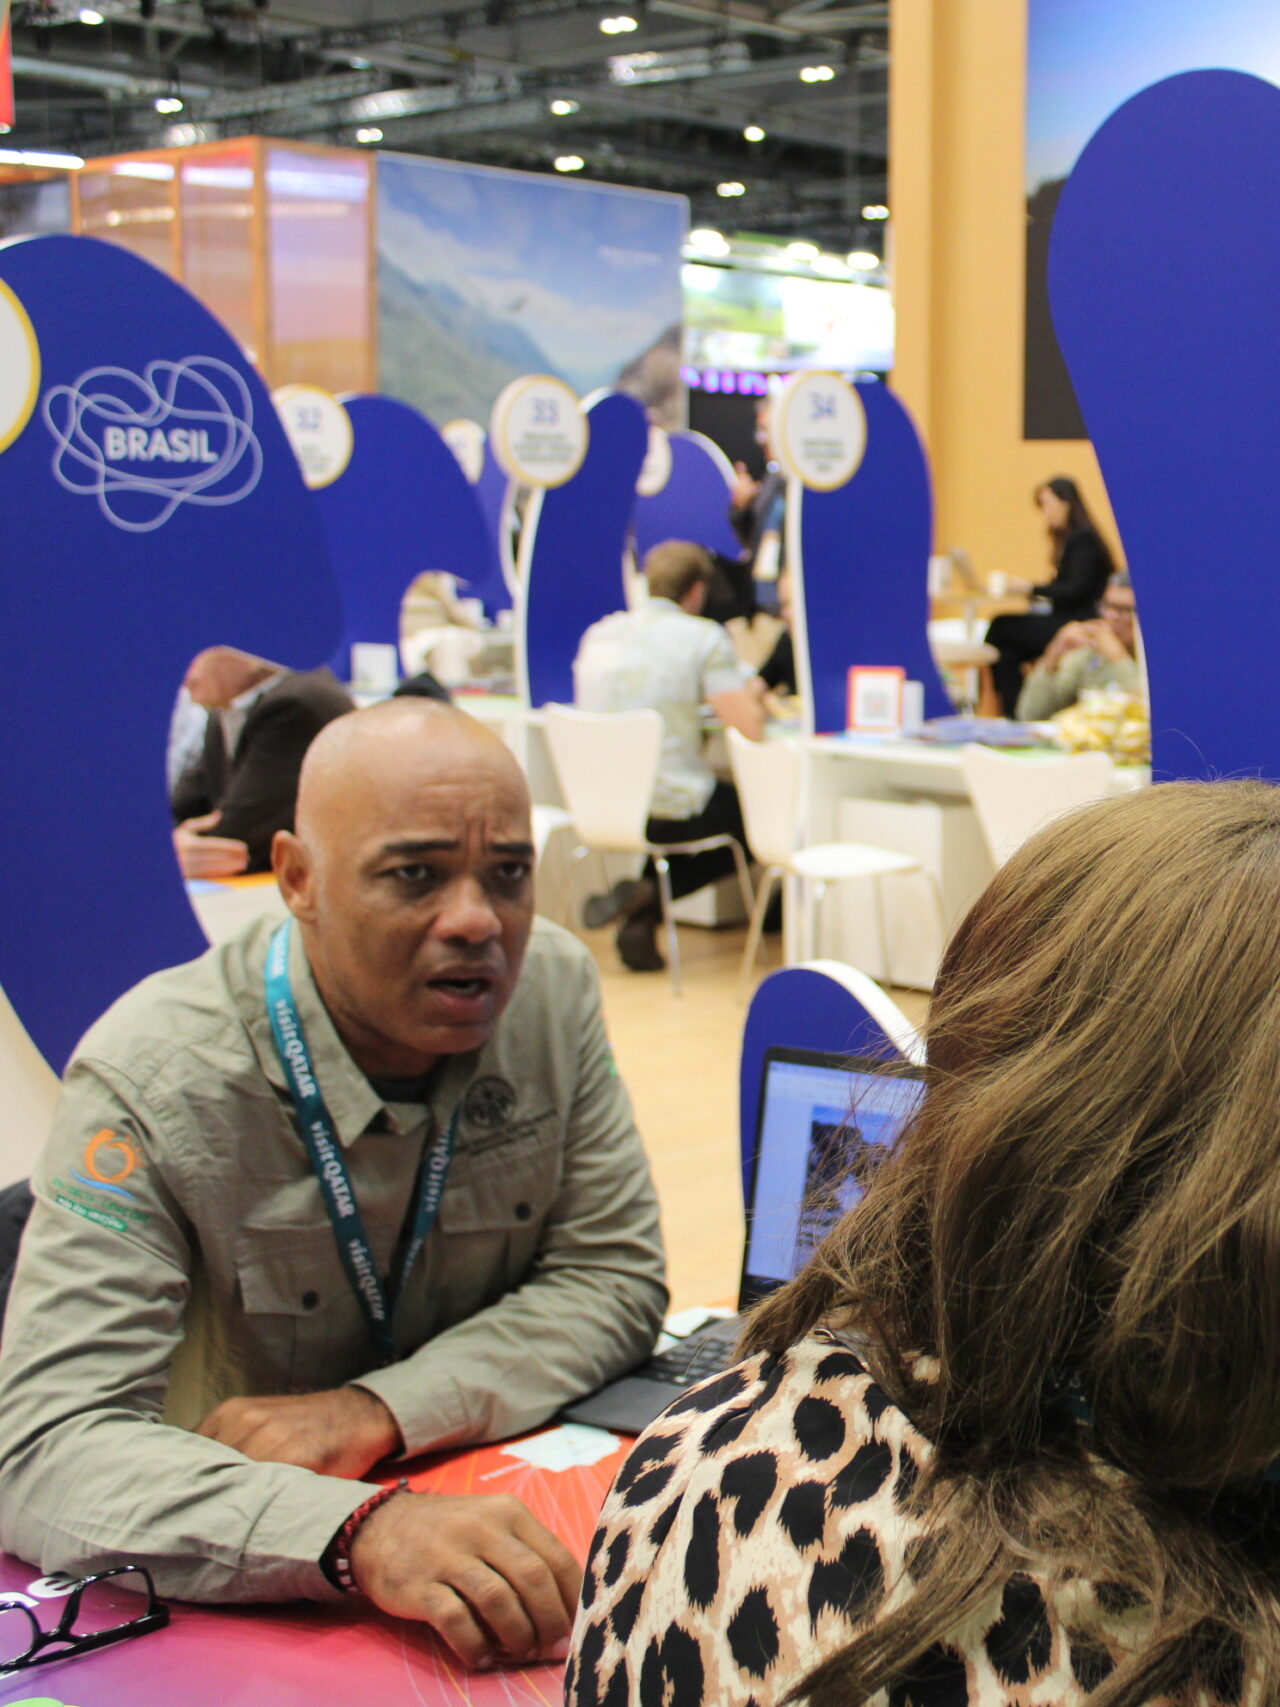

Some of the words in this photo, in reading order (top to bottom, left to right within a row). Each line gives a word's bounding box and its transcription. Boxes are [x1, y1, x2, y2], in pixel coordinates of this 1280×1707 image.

[103, 425, 220, 463] BRASIL
[275, 998, 317, 1099] visitQATAR
[310, 1120, 355, 1219] visitQATAR
